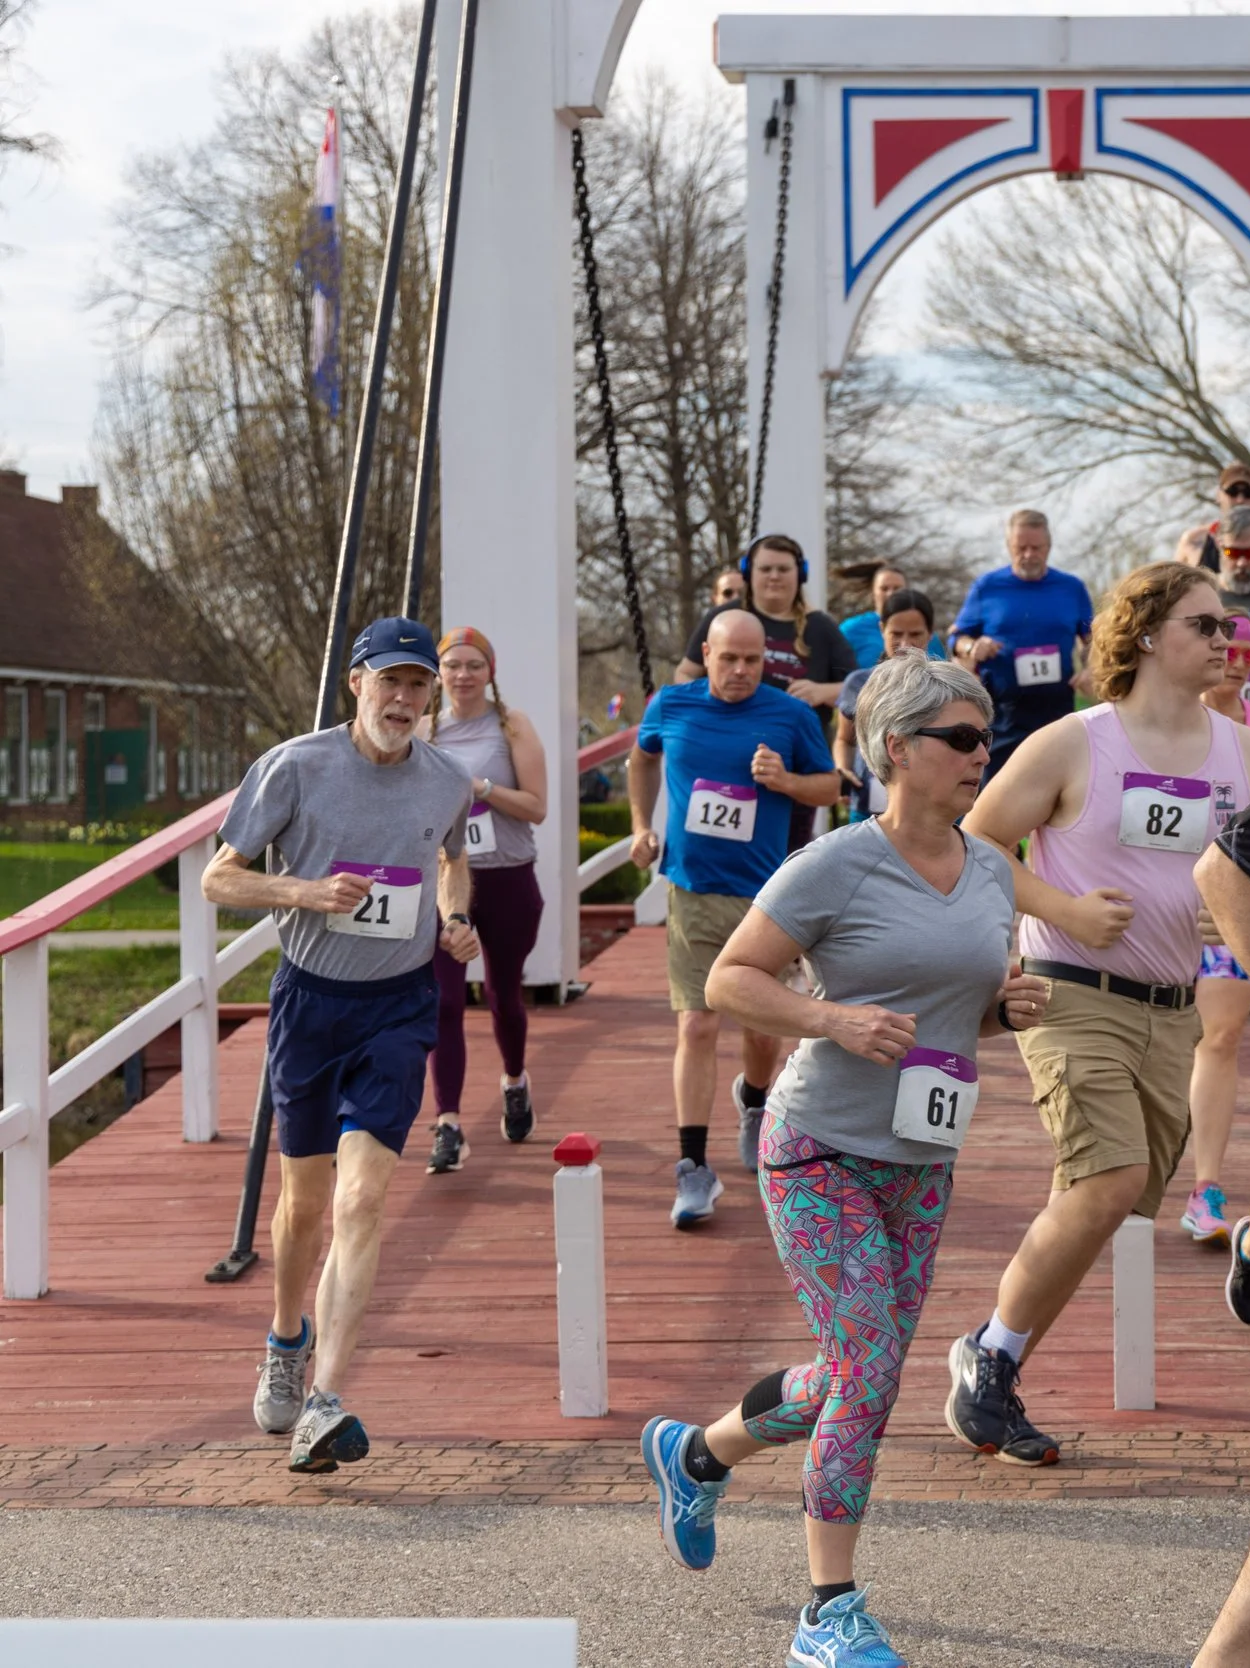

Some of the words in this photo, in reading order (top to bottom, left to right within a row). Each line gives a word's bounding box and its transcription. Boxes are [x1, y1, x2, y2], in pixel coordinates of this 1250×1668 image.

[1030, 660, 1049, 677] 18
[700, 802, 742, 830] 124
[1146, 803, 1183, 838] 82
[353, 893, 391, 925] 21
[927, 1086, 959, 1130] 61
